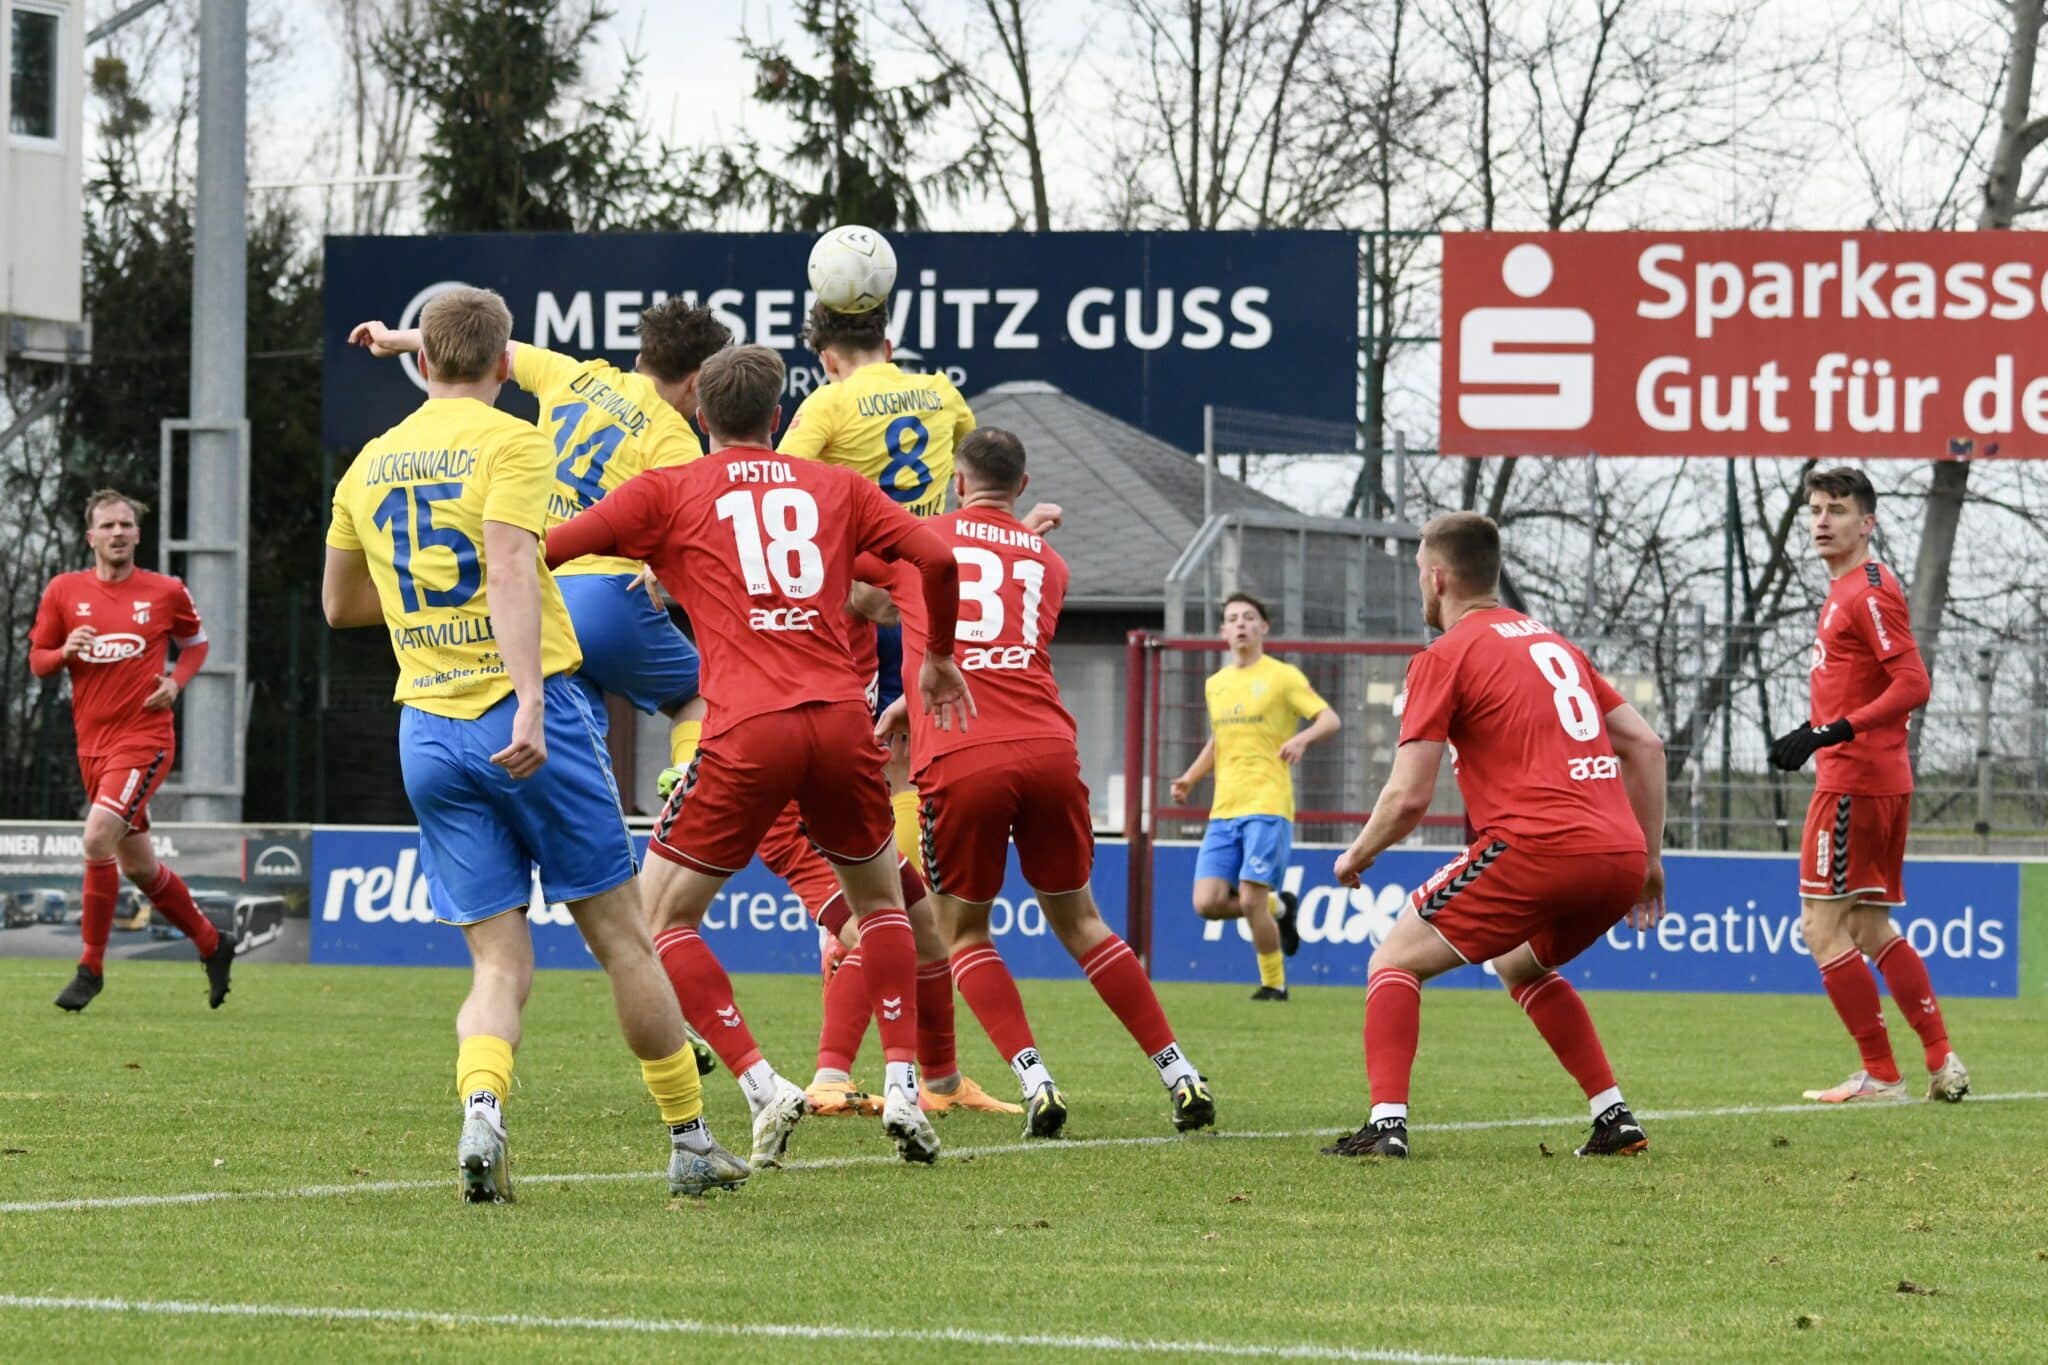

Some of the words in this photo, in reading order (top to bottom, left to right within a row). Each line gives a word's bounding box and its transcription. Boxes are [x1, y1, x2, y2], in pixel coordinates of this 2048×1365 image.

[1066, 286, 1273, 350] GUSS
[1636, 240, 2048, 338] Sparkass
[1636, 356, 1790, 432] Gut
[1810, 353, 1939, 433] für
[367, 448, 477, 486] LUCKENWALDE
[551, 402, 626, 508] 14
[727, 460, 797, 483] PISTOL
[879, 416, 933, 503] 8
[372, 482, 482, 614] 15
[715, 487, 824, 599] 18
[749, 607, 820, 631] acer
[952, 546, 1045, 647] 31
[961, 646, 1036, 671] acer
[1529, 641, 1600, 742] 8
